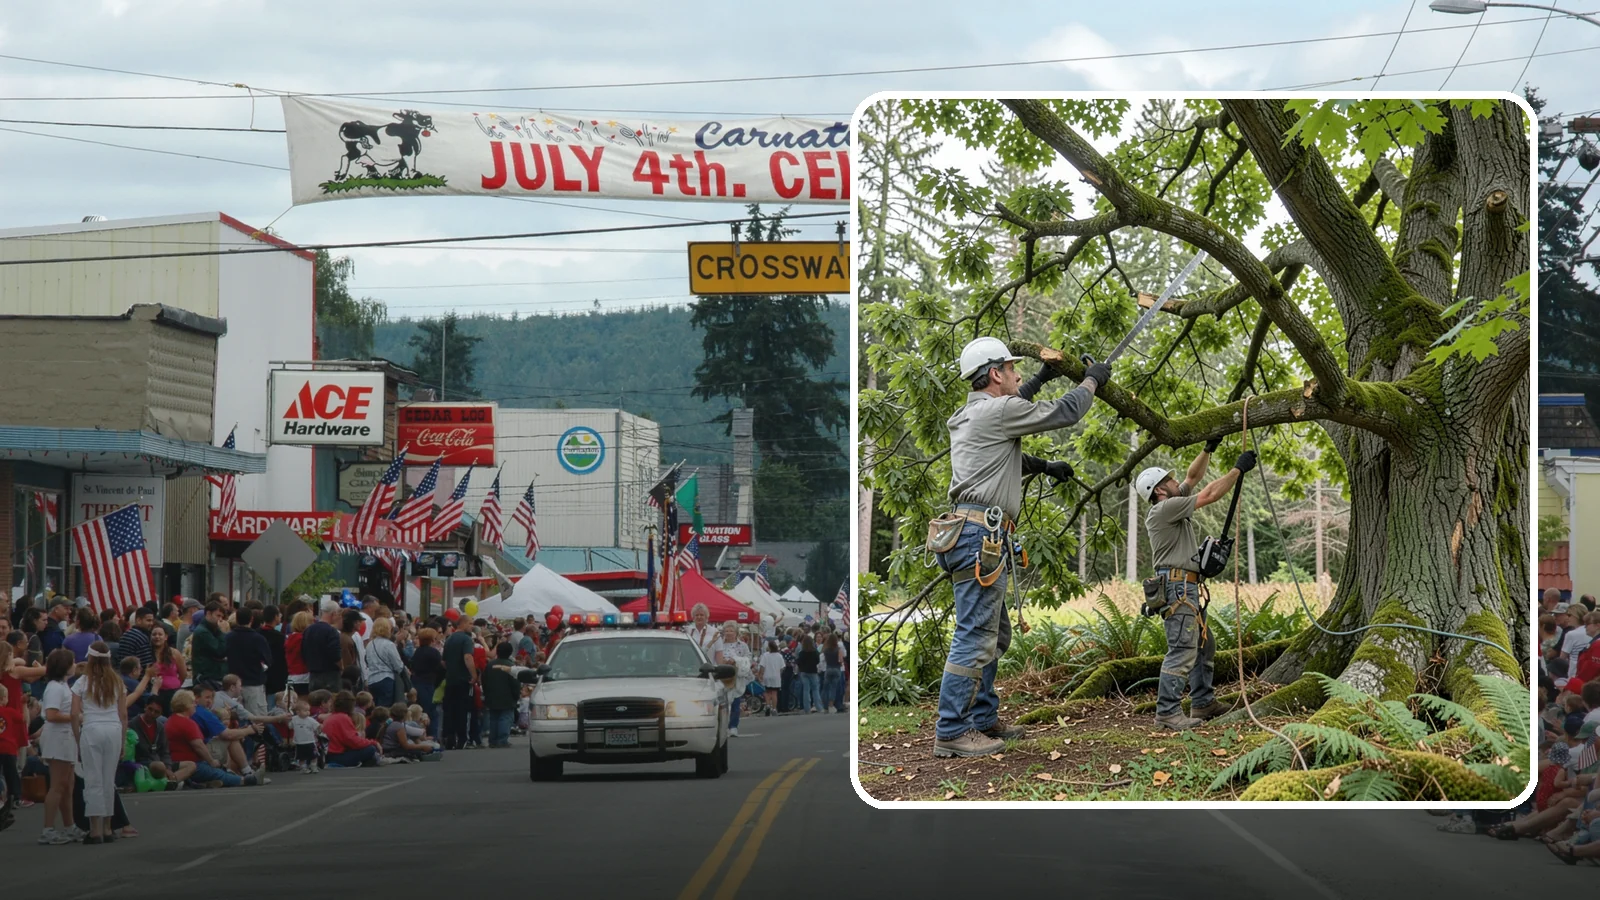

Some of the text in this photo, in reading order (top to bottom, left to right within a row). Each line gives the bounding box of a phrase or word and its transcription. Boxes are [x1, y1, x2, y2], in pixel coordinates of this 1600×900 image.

[481, 140, 604, 192] JULY
[632, 150, 746, 197] 4th.
[697, 254, 850, 279] CROSSWA
[282, 379, 374, 420] ACE
[405, 409, 452, 422] CEDAR
[283, 421, 370, 436] Hardware
[416, 428, 477, 447] Coca-Cola
[353, 467, 385, 479] Simpl
[95, 484, 124, 494] Vincent
[126, 485, 136, 495] de
[137, 485, 155, 495] Paul
[699, 535, 730, 543] GLASS
